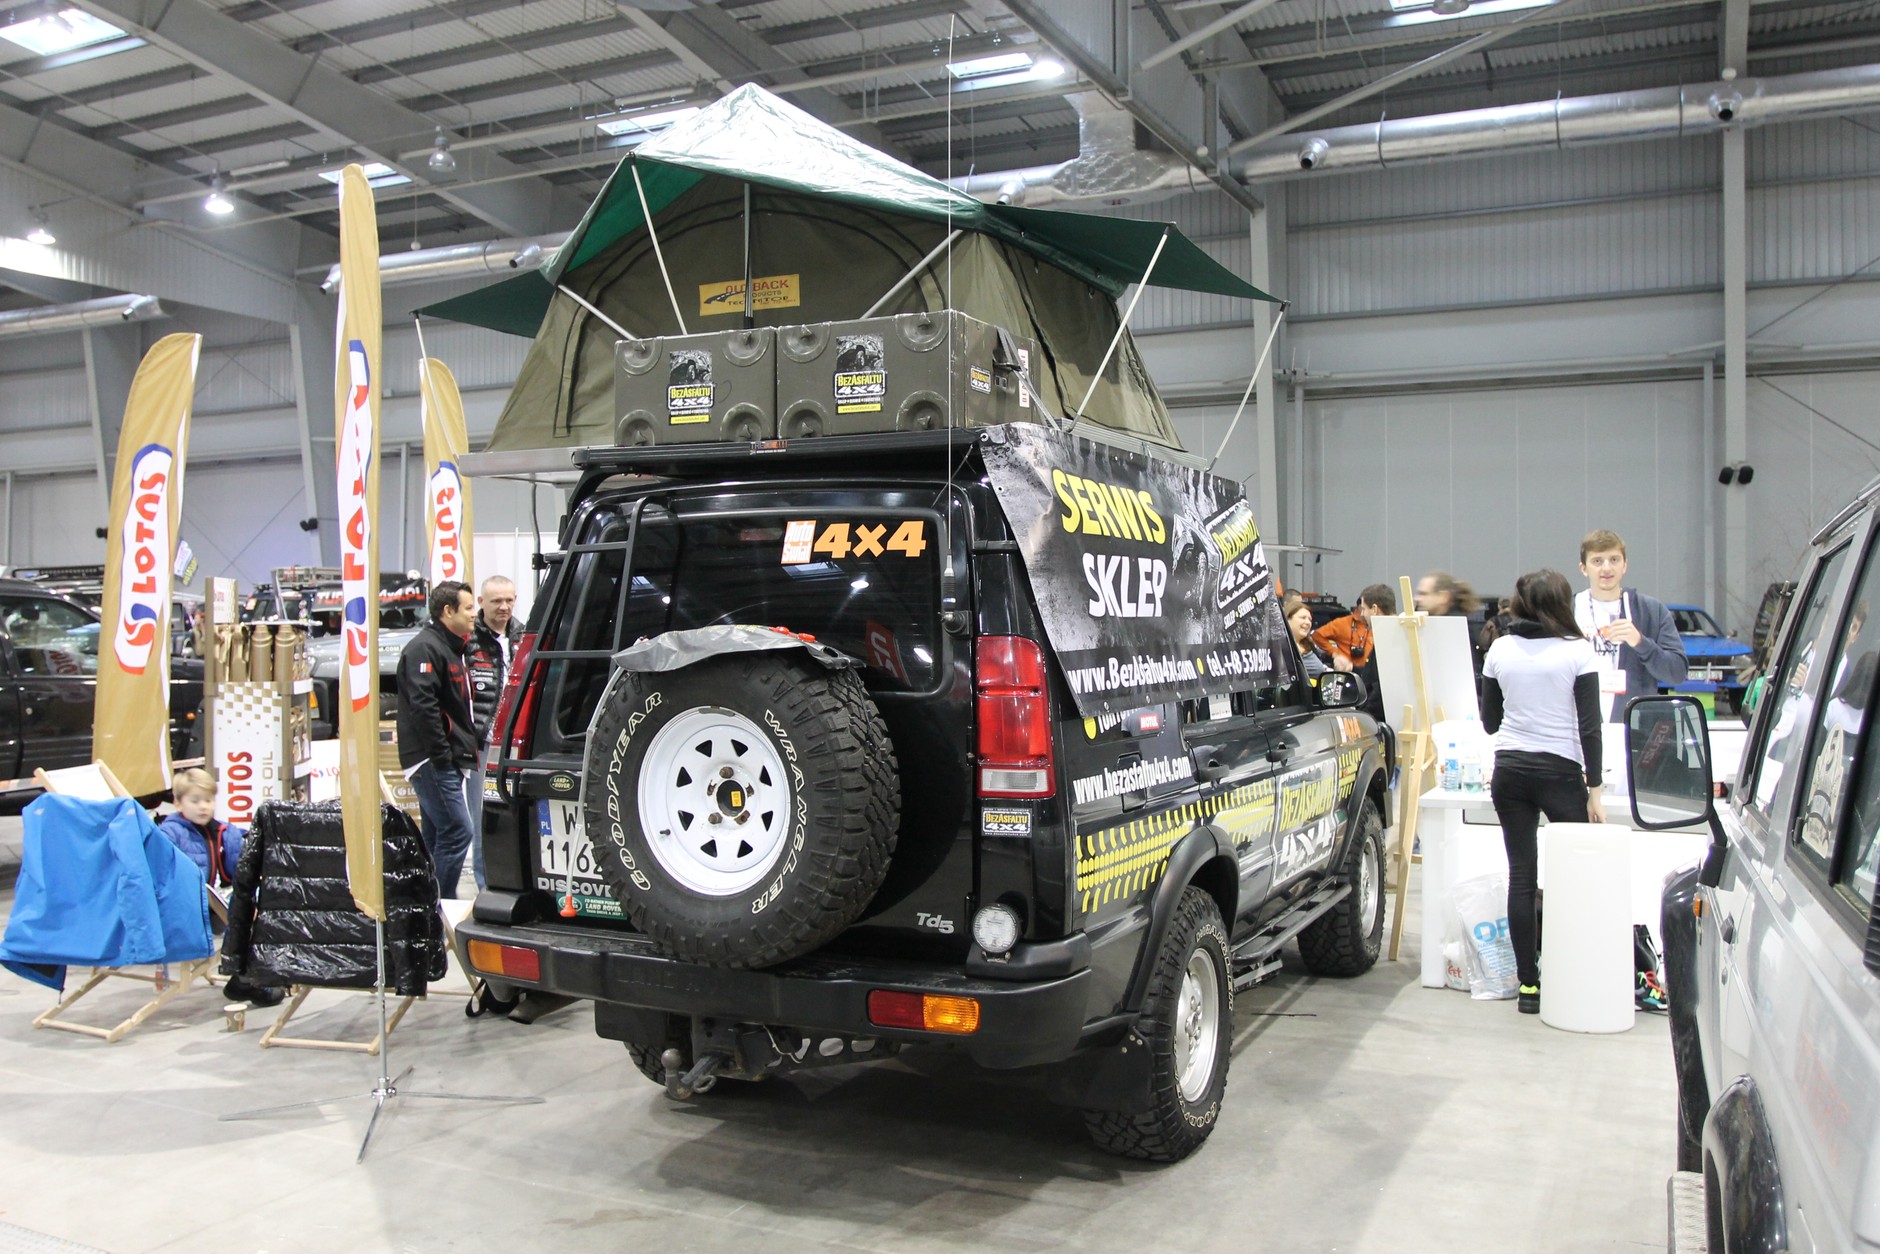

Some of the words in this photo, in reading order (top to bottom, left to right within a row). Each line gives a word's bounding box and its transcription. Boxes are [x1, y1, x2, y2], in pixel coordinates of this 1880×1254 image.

[726, 280, 789, 293] OUBACK
[1052, 468, 1167, 544] SERWIS
[131, 472, 167, 593] LOTOS
[814, 520, 926, 559] 4x4
[1082, 552, 1168, 618] SKLEP
[227, 751, 253, 823] LOTOS
[607, 692, 662, 891] GOODYEAR
[1073, 755, 1193, 805] www.bezasfaltu4x4.com
[541, 820, 551, 830] PL
[752, 709, 807, 914] WRANGLER
[985, 813, 1028, 824] BEZASFALTU
[585, 903, 602, 911] LAND
[602, 904, 622, 912] ROVER
[916, 912, 955, 934] Td5
